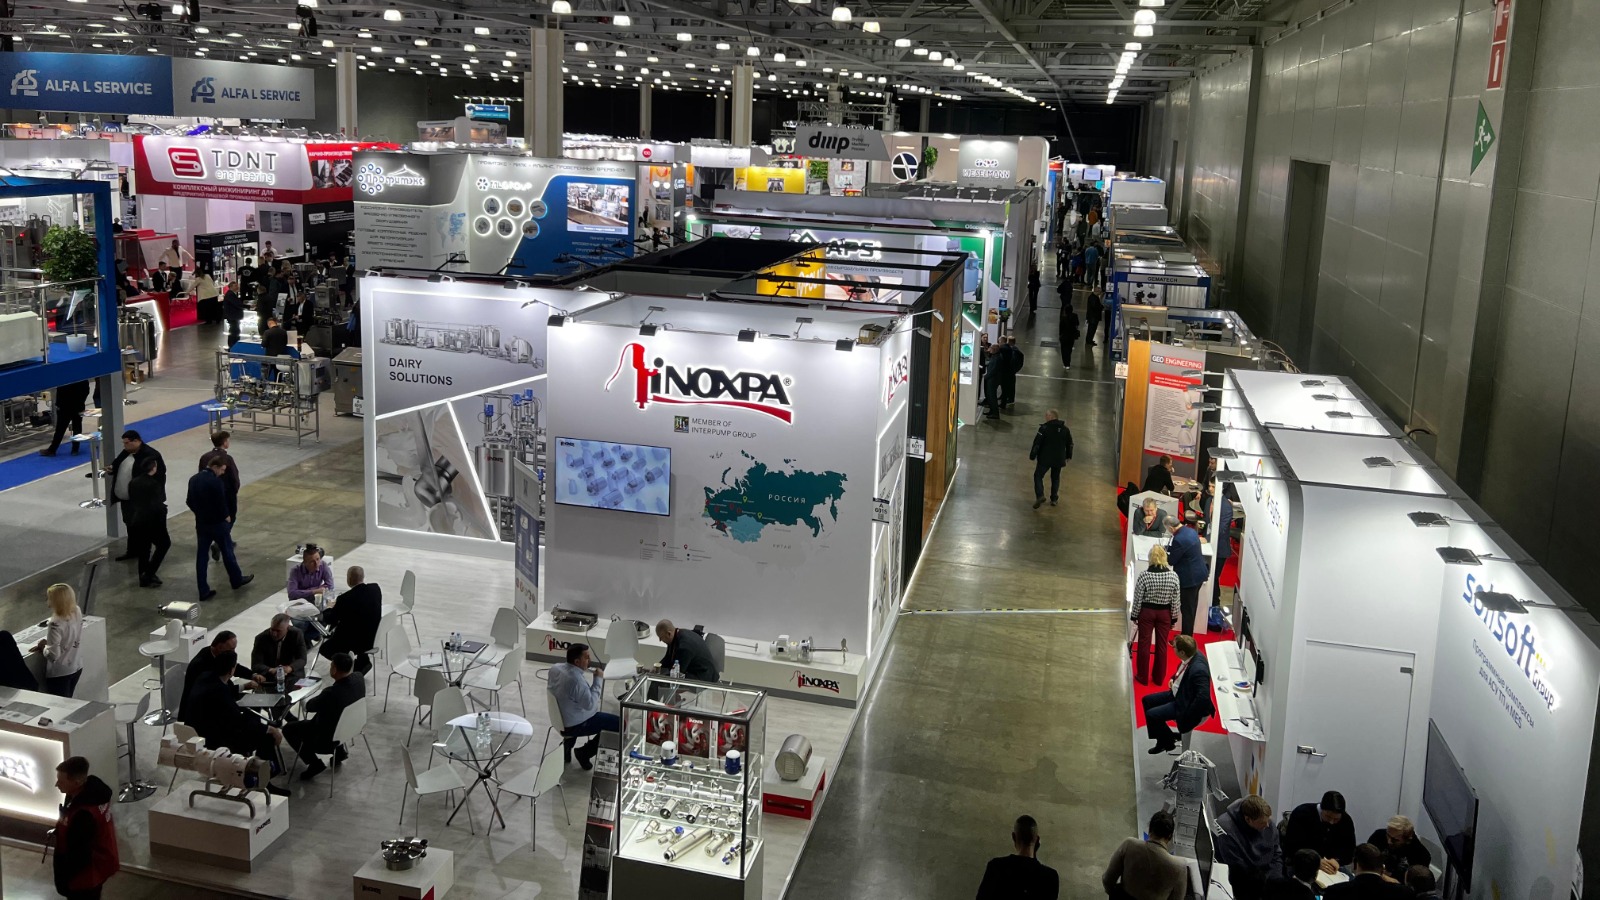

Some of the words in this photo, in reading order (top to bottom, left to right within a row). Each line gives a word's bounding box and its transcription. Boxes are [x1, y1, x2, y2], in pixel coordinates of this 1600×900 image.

[45, 79, 78, 93] ALFA
[83, 81, 91, 93] L
[94, 81, 152, 95] SERVICE
[221, 87, 248, 100] ALFA
[252, 89, 258, 100] L
[260, 90, 300, 102] SERVICE
[212, 150, 277, 170] TDNT
[216, 169, 275, 185] engineering
[962, 168, 1010, 179] KIESELMANN
[173, 184, 217, 193] КОМПЛЕКСНЫЙ
[218, 186, 260, 195] ИНЖИНИРИНГ
[826, 240, 873, 257] APS
[389, 357, 422, 369] DAIRY
[1152, 355, 1164, 364] GEO
[1165, 358, 1202, 369] ENGINEERING
[389, 372, 453, 386] SOLUTIONS
[692, 418, 721, 427] MEMBER
[691, 427, 731, 437] INTERPUMP
[732, 431, 757, 439] GROUP
[768, 494, 806, 504] РОССИЯ
[1472, 638, 1505, 690] Программные
[1505, 683, 1535, 728] комплексы
